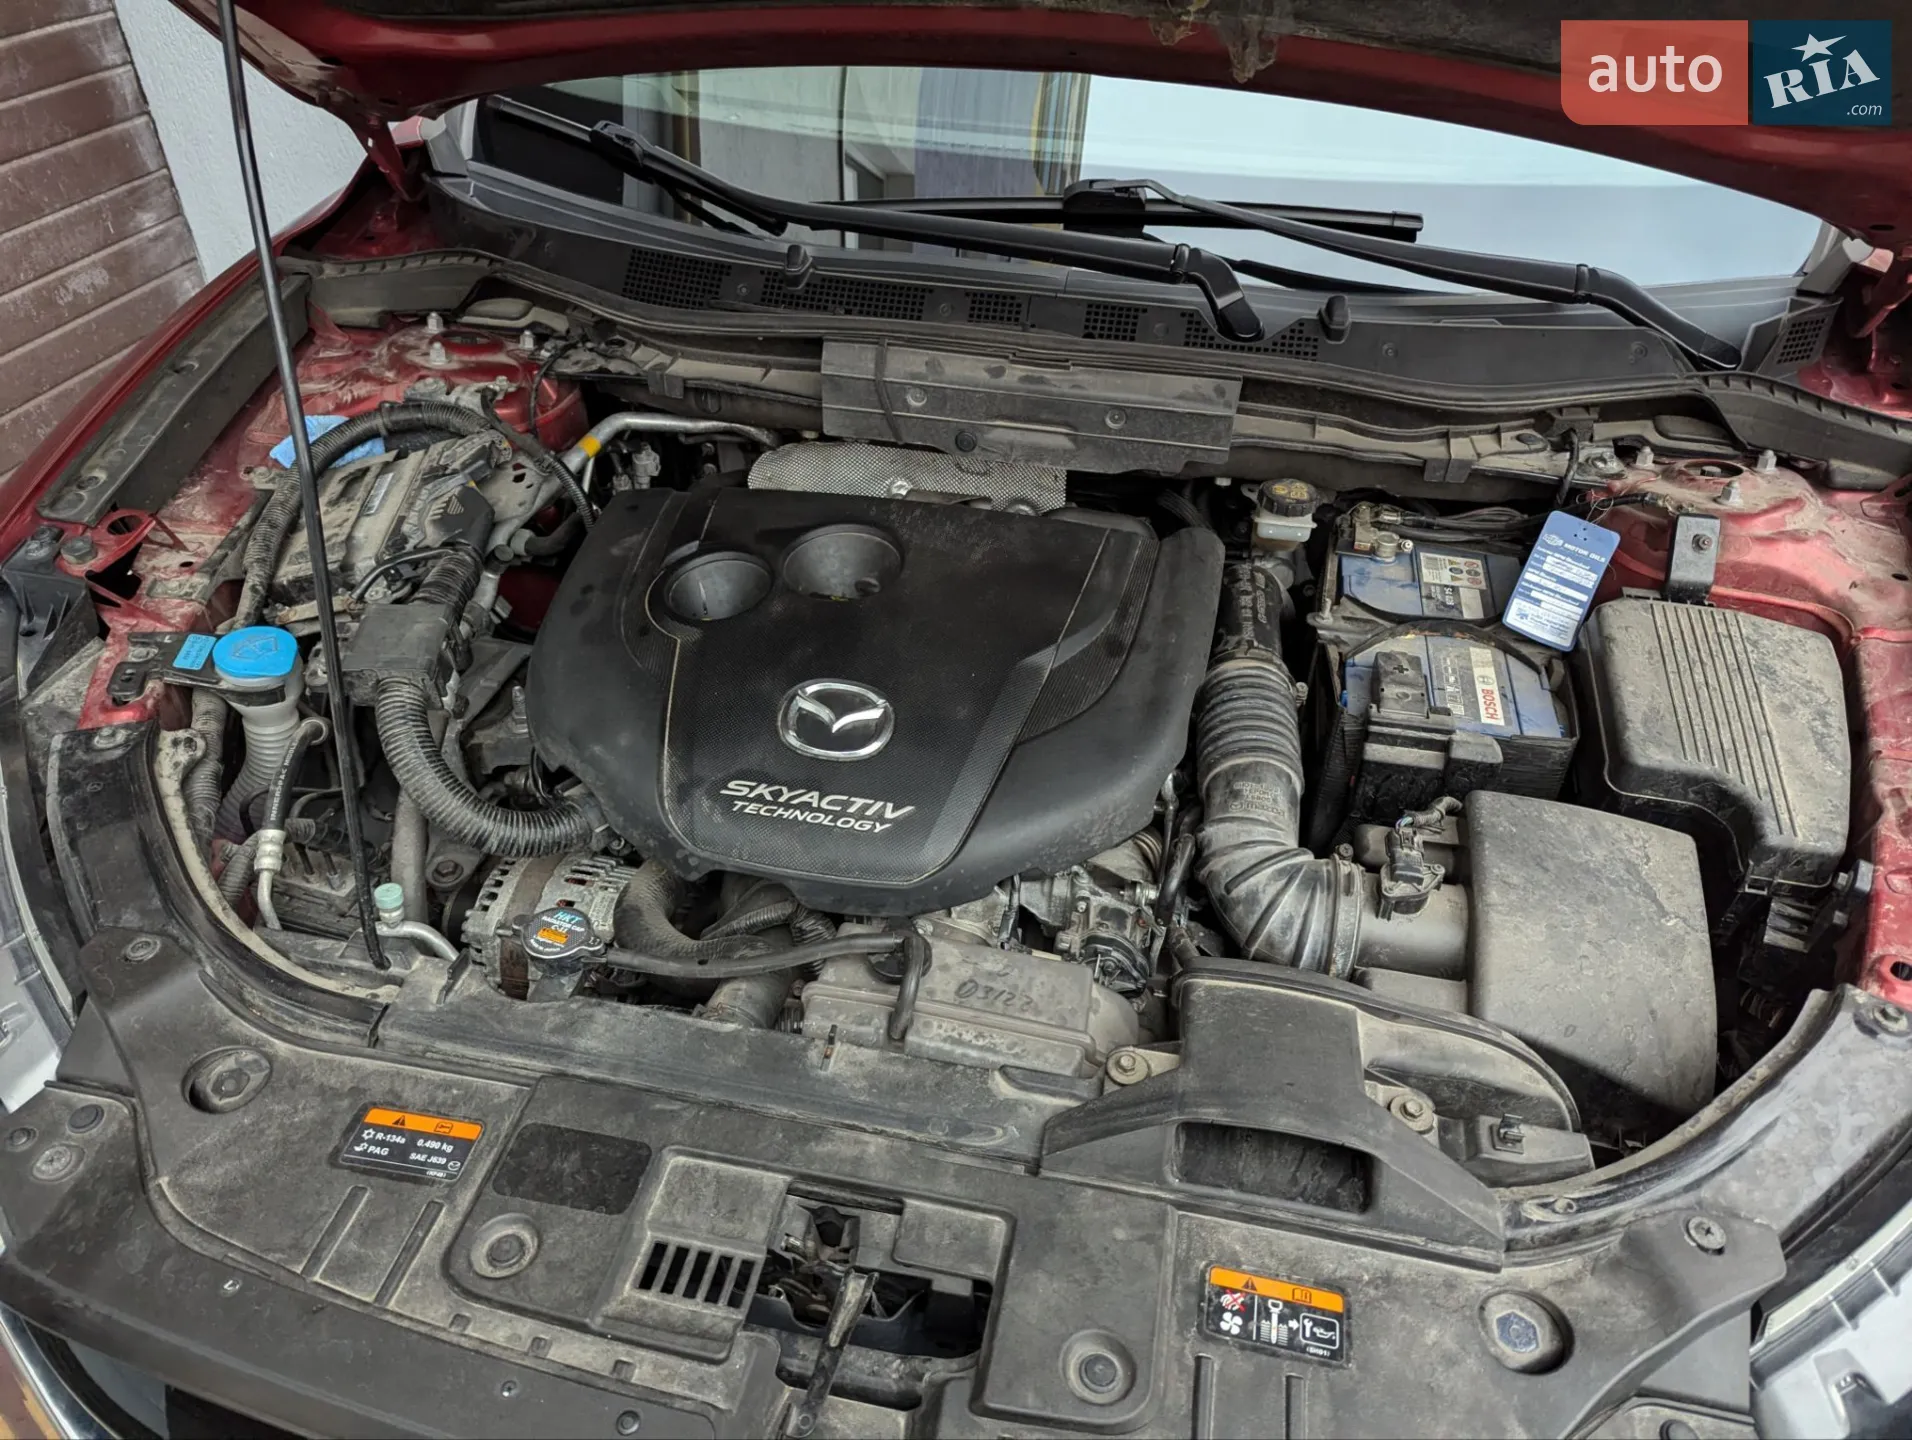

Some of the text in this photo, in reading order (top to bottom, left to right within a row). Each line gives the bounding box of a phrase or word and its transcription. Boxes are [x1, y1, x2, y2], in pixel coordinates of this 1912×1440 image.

[1481, 688, 1500, 720] BOSCH
[719, 779, 916, 820] SKYACTIV
[732, 800, 892, 833] TECHNOLOGY
[367, 1145, 390, 1156] PAG
[409, 1152, 428, 1162] SAE
[375, 1132, 454, 1154] R-134a 0.490 kg
